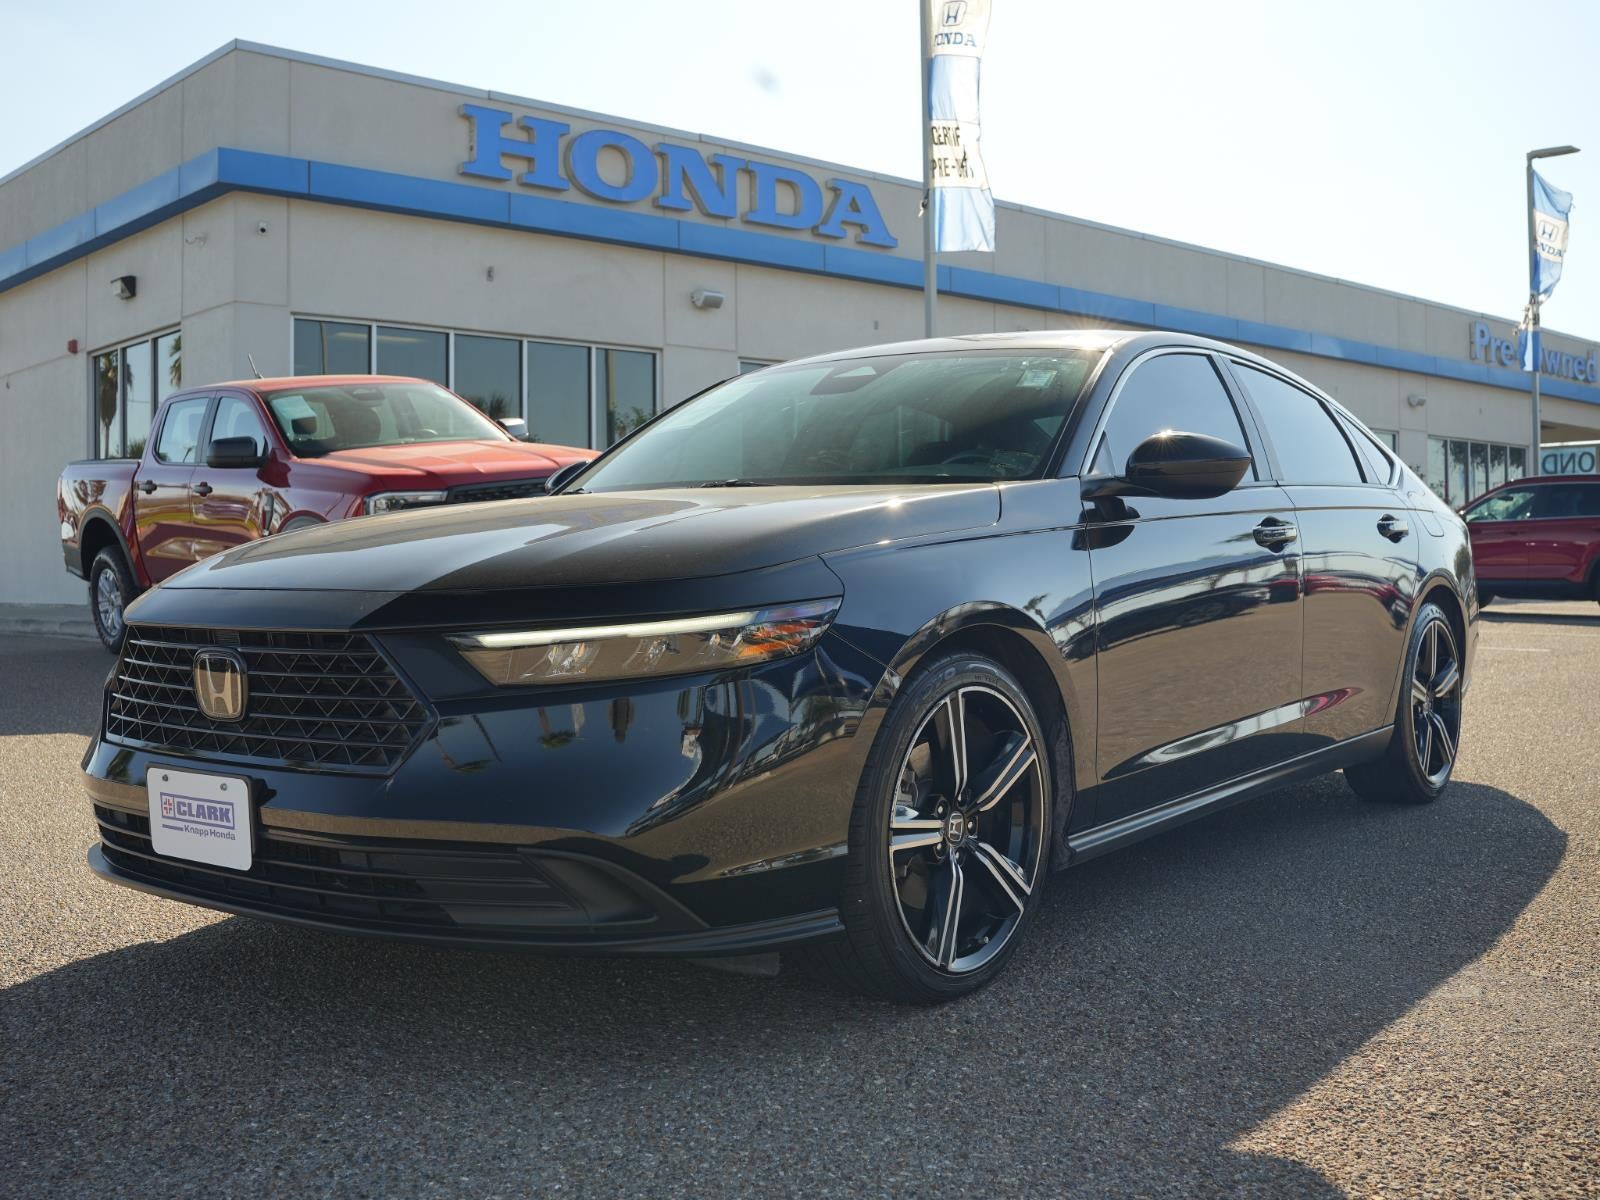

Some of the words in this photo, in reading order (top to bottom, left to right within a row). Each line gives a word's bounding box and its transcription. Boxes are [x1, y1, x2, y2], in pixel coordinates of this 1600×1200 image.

[934, 32, 977, 47] ONDA
[459, 103, 898, 248] HONDA
[1472, 320, 1598, 383] Pre-wned
[176, 801, 231, 823] CLARK
[184, 825, 209, 838] Knapp
[209, 829, 236, 841] Honda
